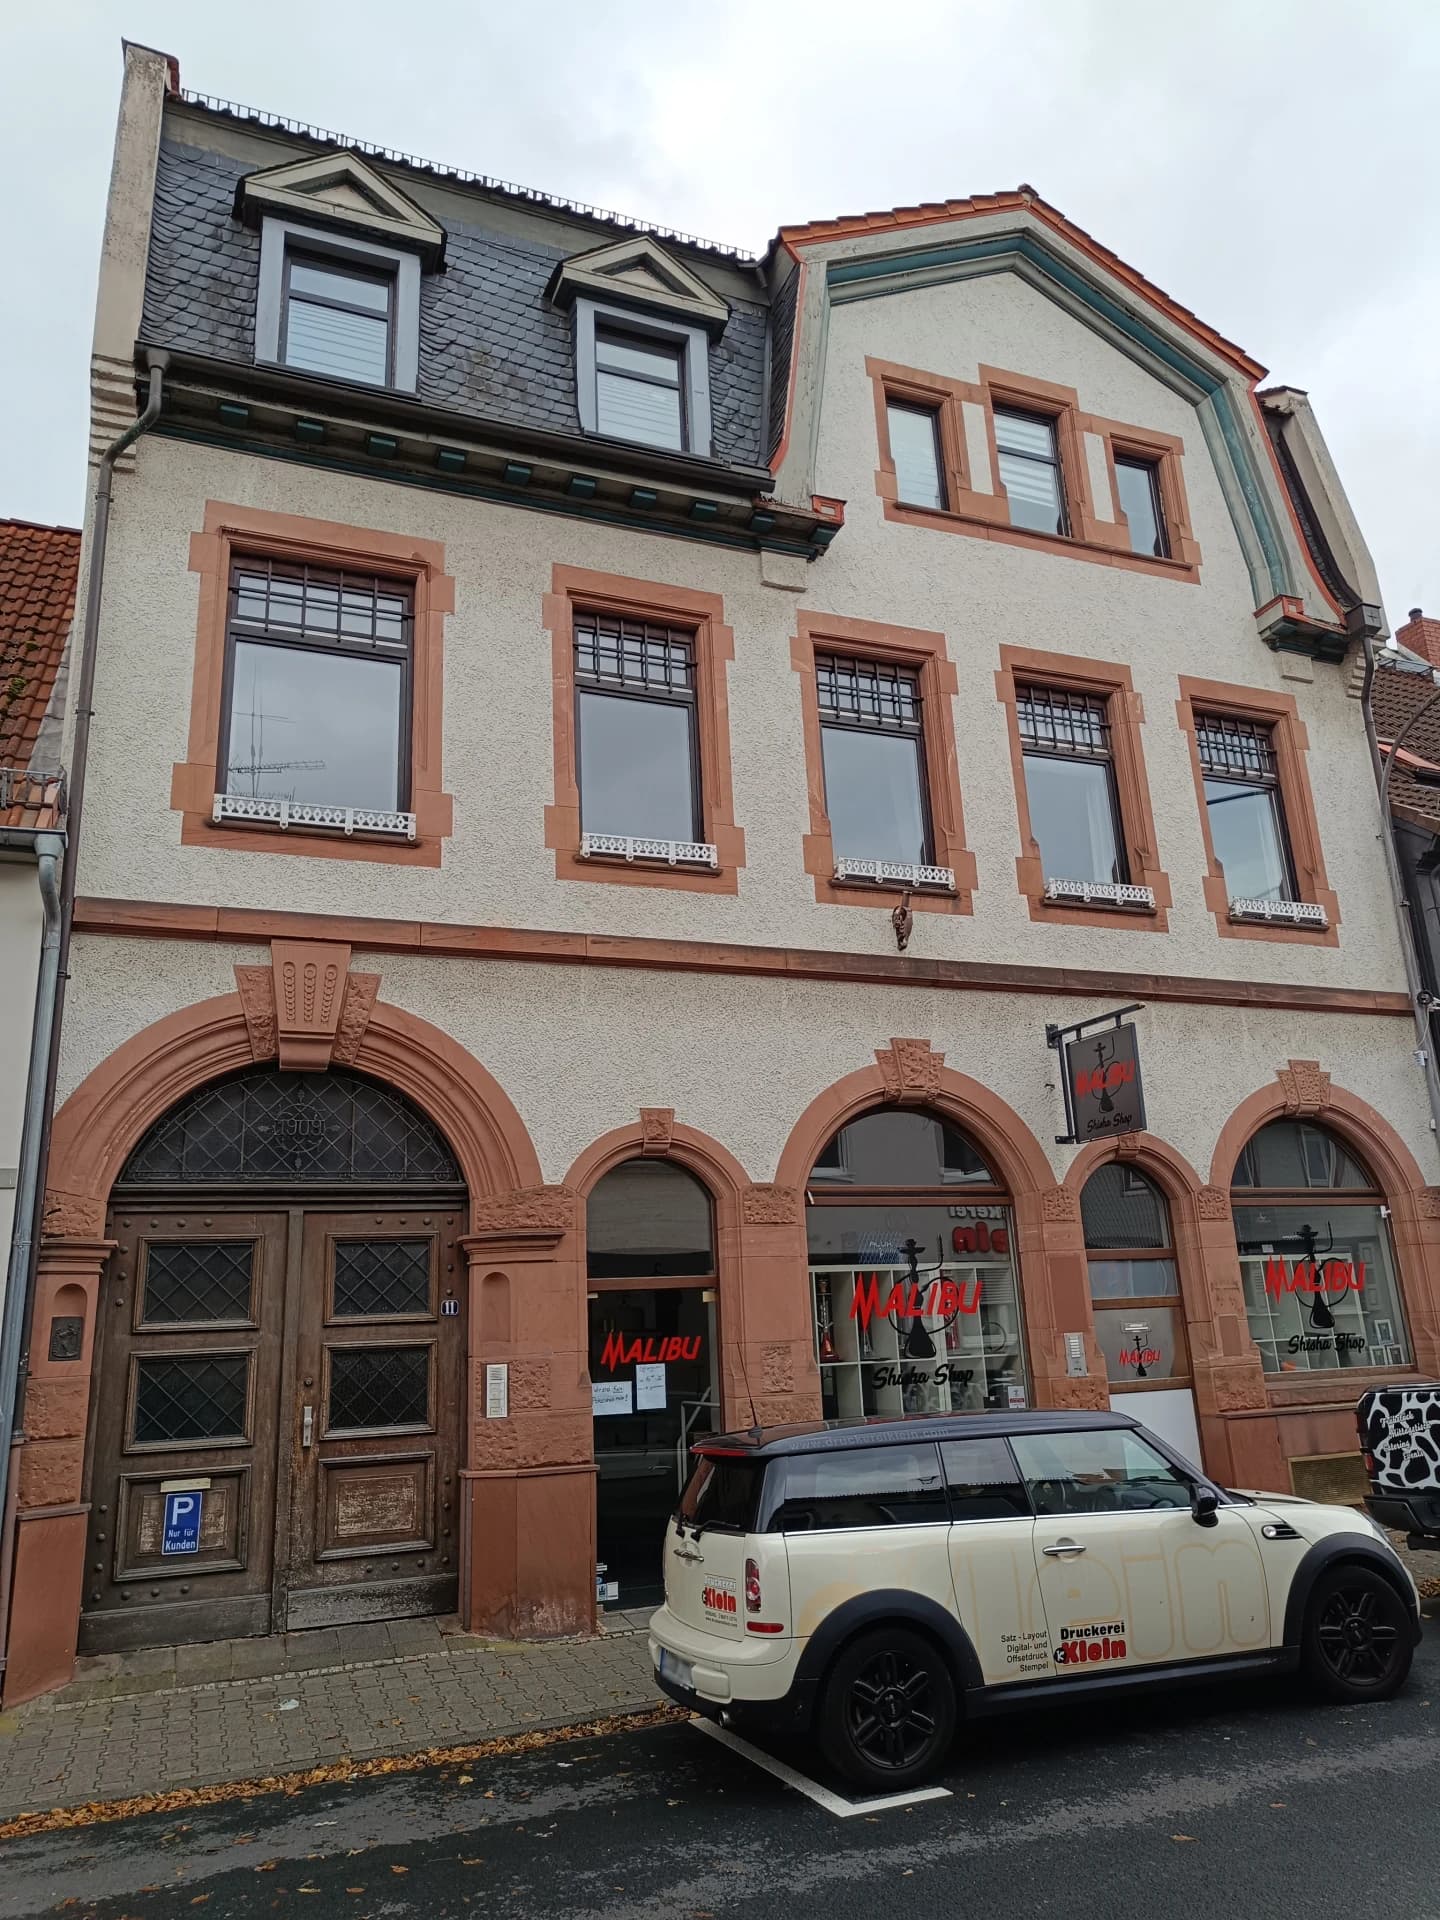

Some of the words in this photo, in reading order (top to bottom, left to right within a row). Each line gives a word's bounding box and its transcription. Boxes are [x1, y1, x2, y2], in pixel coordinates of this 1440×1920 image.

[1075, 1059, 1135, 1098] MALIBU
[1087, 1115, 1112, 1133] Shisha
[1113, 1112, 1132, 1127] Shop
[1265, 1253, 1366, 1305] MALIBU
[445, 1302, 454, 1314] 11
[849, 1271, 983, 1334] MALIBU
[600, 1328, 702, 1374] MALIBU
[1287, 1334, 1332, 1354] Shisha
[1335, 1333, 1366, 1353] Shop
[1119, 1348, 1161, 1368] MALIBU
[872, 1367, 930, 1389] Shisha
[933, 1364, 973, 1386] Shop
[172, 1497, 194, 1525] P
[168, 1530, 180, 1538] Nur
[165, 1540, 196, 1551] Kunden
[705, 1587, 737, 1613] Klein
[1001, 1634, 1016, 1642] Satz
[1023, 1631, 1047, 1641] Layout
[1061, 1622, 1125, 1640] Druckerei
[1007, 1644, 1032, 1653] Digital-
[1034, 1642, 1047, 1650] und
[1007, 1652, 1048, 1663] Offsetdruck
[1062, 1638, 1126, 1664] Klein
[1020, 1662, 1049, 1672] Stempel
